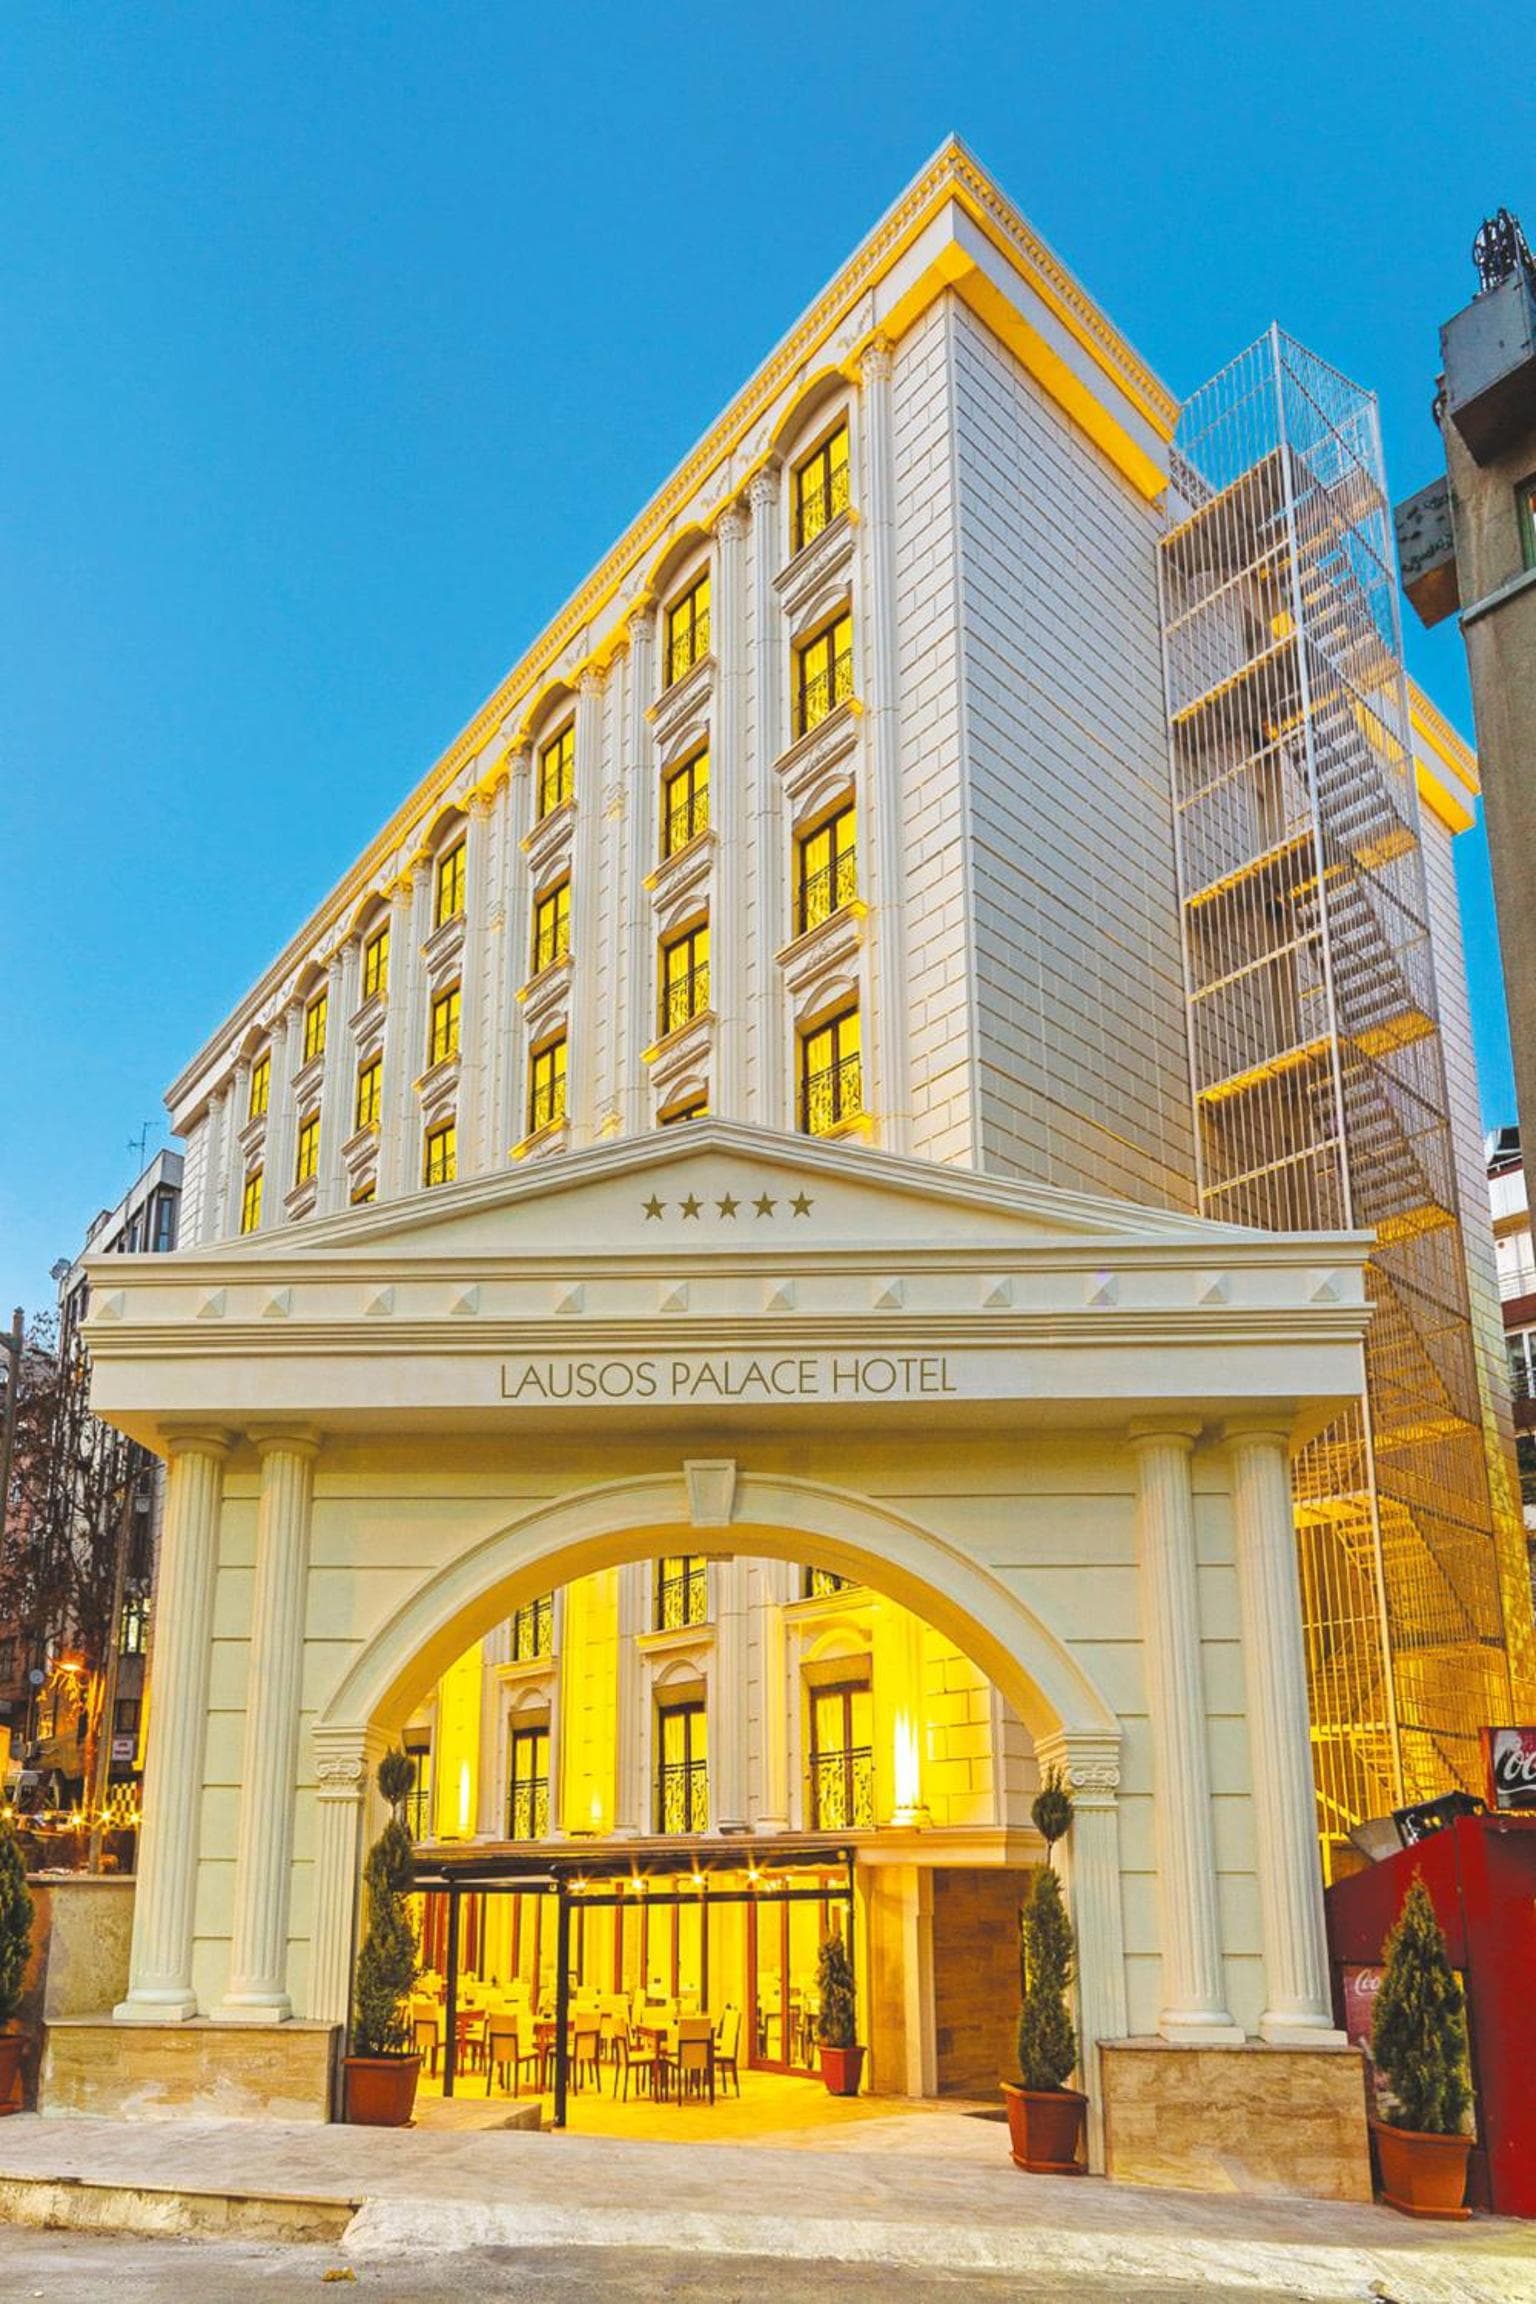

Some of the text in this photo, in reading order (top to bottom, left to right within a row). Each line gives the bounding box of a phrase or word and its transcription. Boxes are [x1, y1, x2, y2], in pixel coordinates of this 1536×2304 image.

[502, 1357, 957, 1398] LAUSOS PALACE HOTEL
